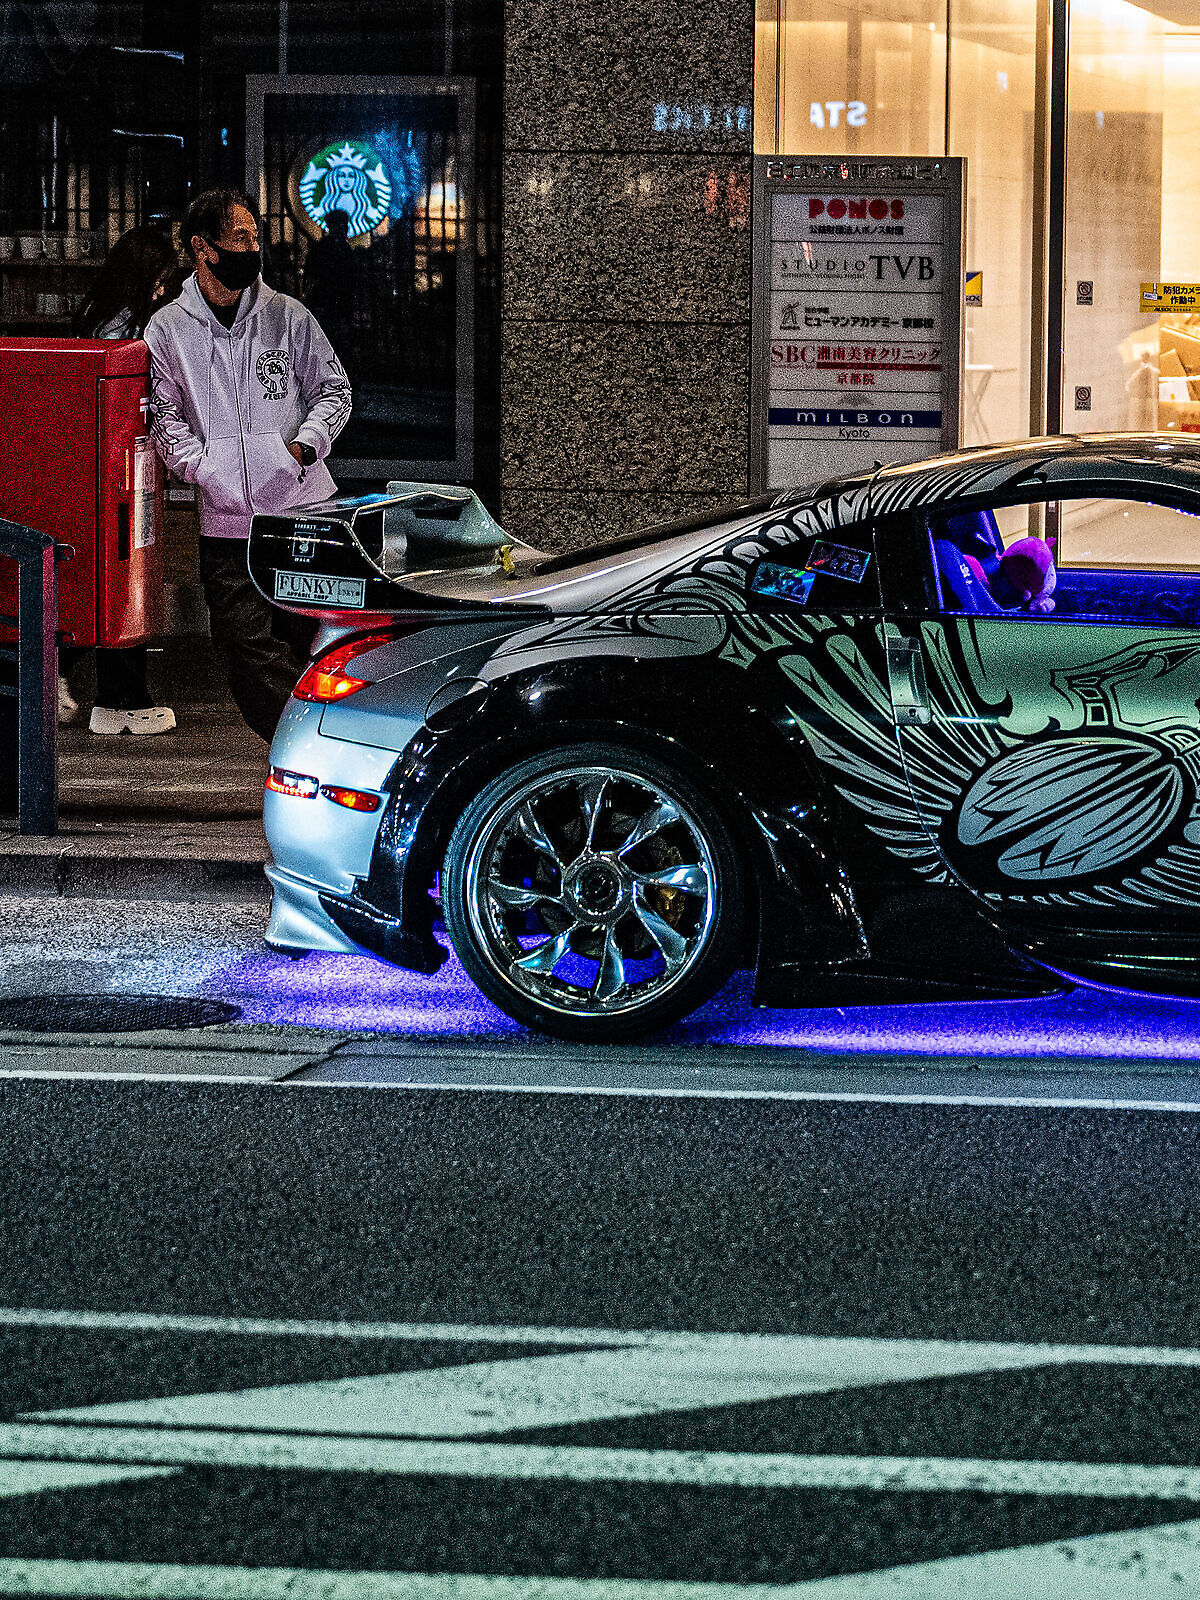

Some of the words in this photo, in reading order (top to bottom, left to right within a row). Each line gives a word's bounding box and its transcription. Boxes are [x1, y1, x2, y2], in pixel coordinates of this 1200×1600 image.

[809, 199, 905, 220] PONOS
[780, 259, 866, 271] STUDIO
[869, 255, 935, 280] TVB
[1170, 296, 1196, 305] 作動中
[804, 316, 899, 328] ヒューマンアカデミー
[770, 345, 815, 363] SBC
[817, 346, 941, 362] 湘南美容クリニック
[837, 373, 875, 385] 京都院
[838, 428, 870, 439] Kyoto
[280, 576, 337, 595] FUNKY
